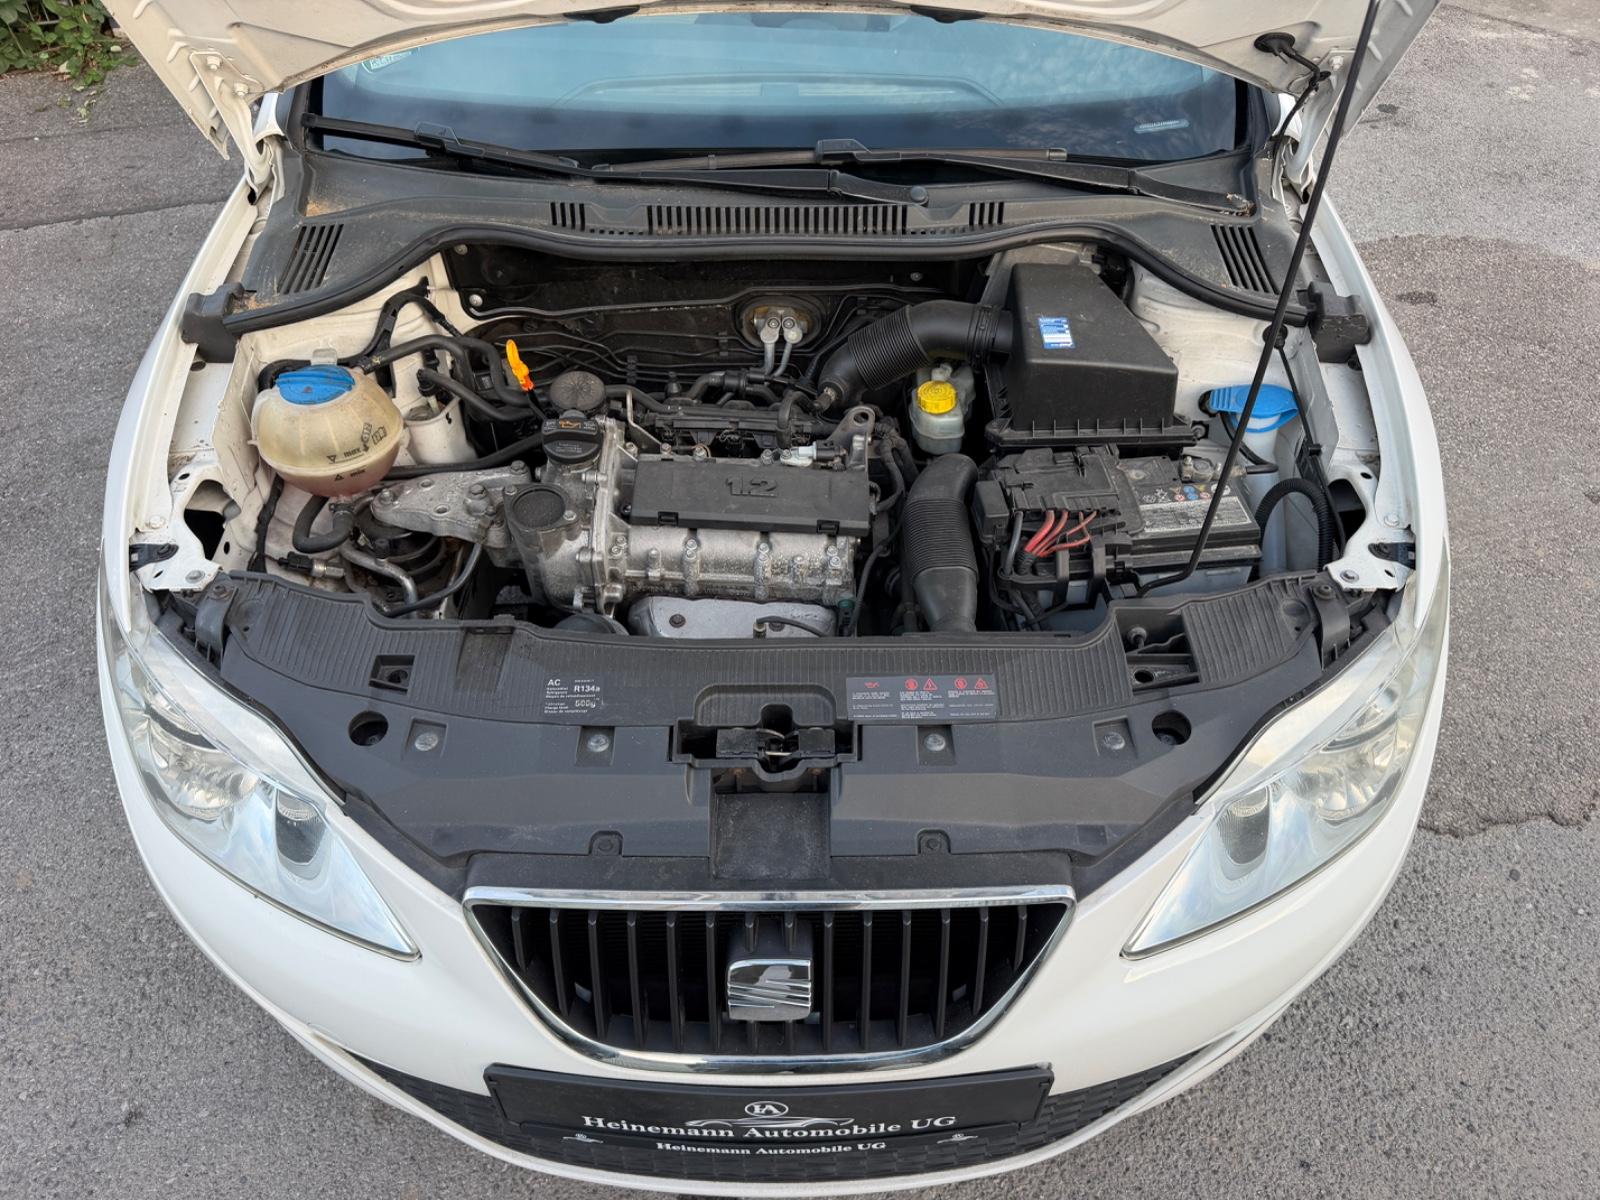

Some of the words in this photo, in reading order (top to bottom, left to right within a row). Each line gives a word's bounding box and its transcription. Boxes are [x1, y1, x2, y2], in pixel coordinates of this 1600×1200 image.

[725, 478, 777, 498] 1.2
[547, 678, 561, 686] AC
[573, 684, 600, 693] R134a
[581, 1114, 734, 1138] Heinemann
[743, 1122, 901, 1138] Automobile
[910, 1116, 956, 1129] UG
[656, 1142, 751, 1155] Heinemann
[755, 1143, 852, 1155] Automobile
[857, 1142, 887, 1151] UG
